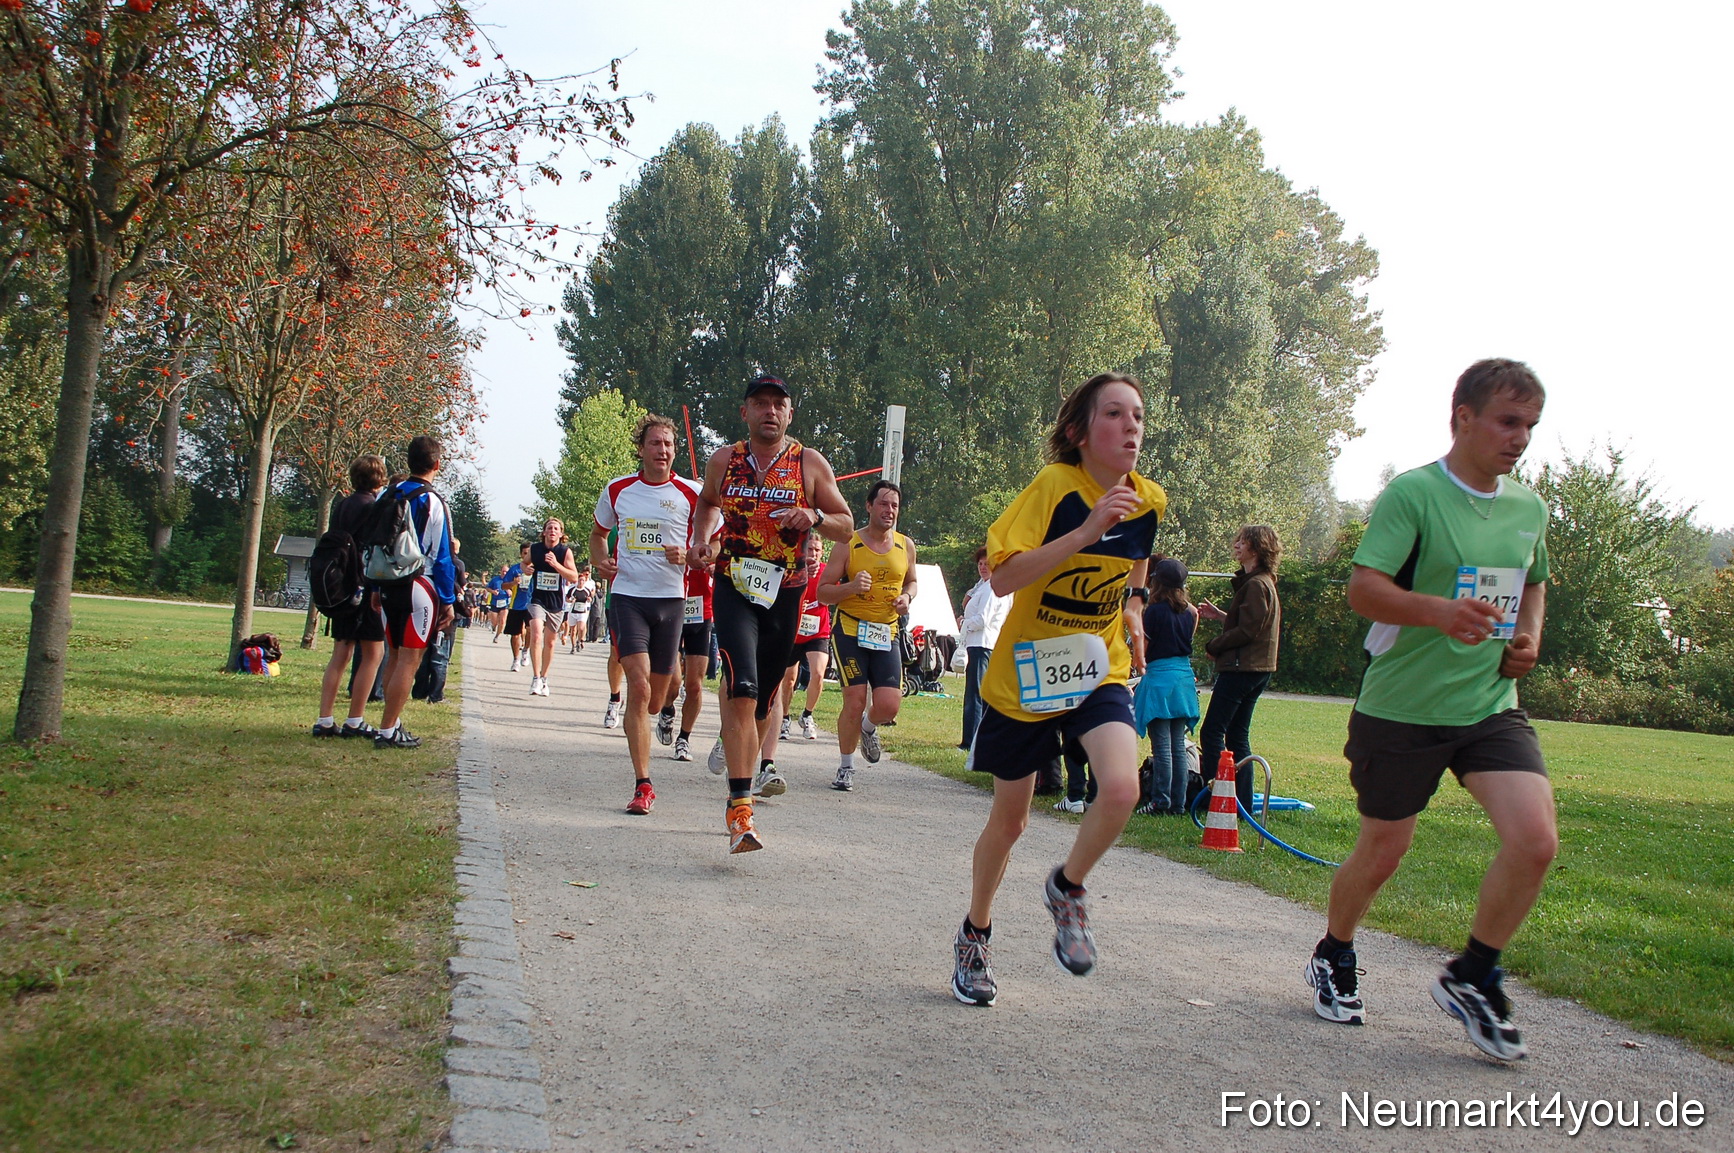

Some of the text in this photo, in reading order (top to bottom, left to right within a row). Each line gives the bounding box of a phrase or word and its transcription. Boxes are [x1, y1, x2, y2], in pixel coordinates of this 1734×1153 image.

[726, 484, 796, 500] triathlon
[636, 521, 659, 530] Michael
[640, 533, 662, 544] 696
[743, 560, 769, 575] Helmut
[746, 574, 770, 593] 194
[684, 606, 700, 615] 591
[1045, 659, 1099, 685] 3844
